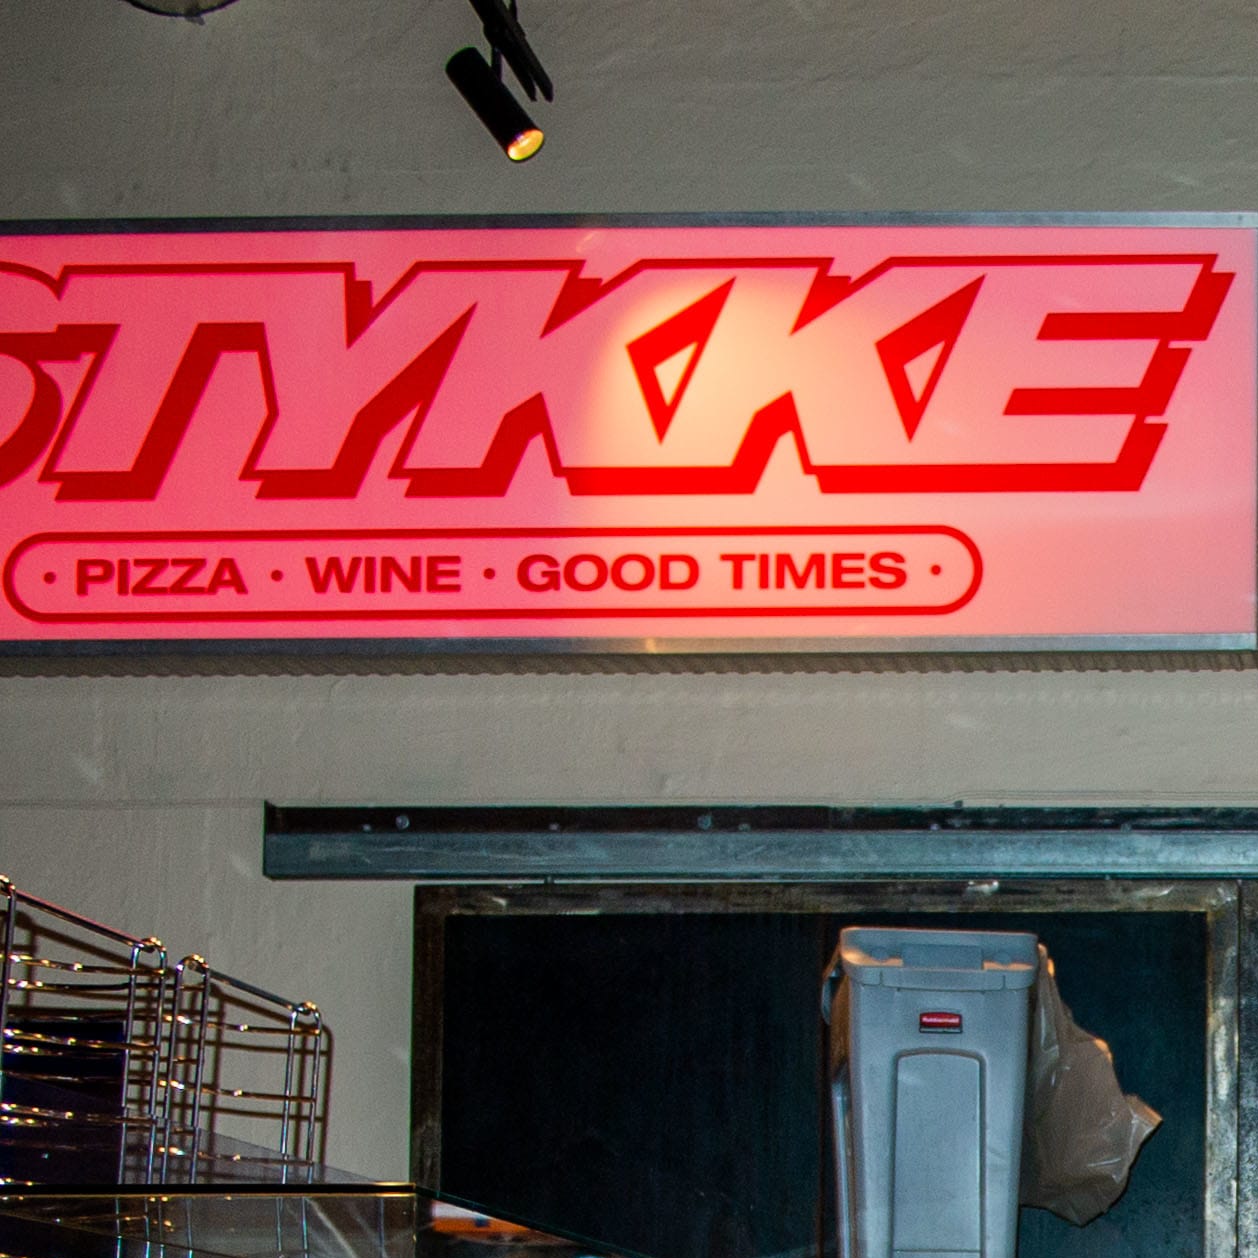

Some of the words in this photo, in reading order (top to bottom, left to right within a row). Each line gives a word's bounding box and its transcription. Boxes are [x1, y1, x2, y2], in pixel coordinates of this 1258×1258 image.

[76, 558, 248, 595] PIZZA
[305, 556, 461, 594] WINE
[517, 554, 699, 592] GOOD
[721, 552, 906, 589] TIMES
